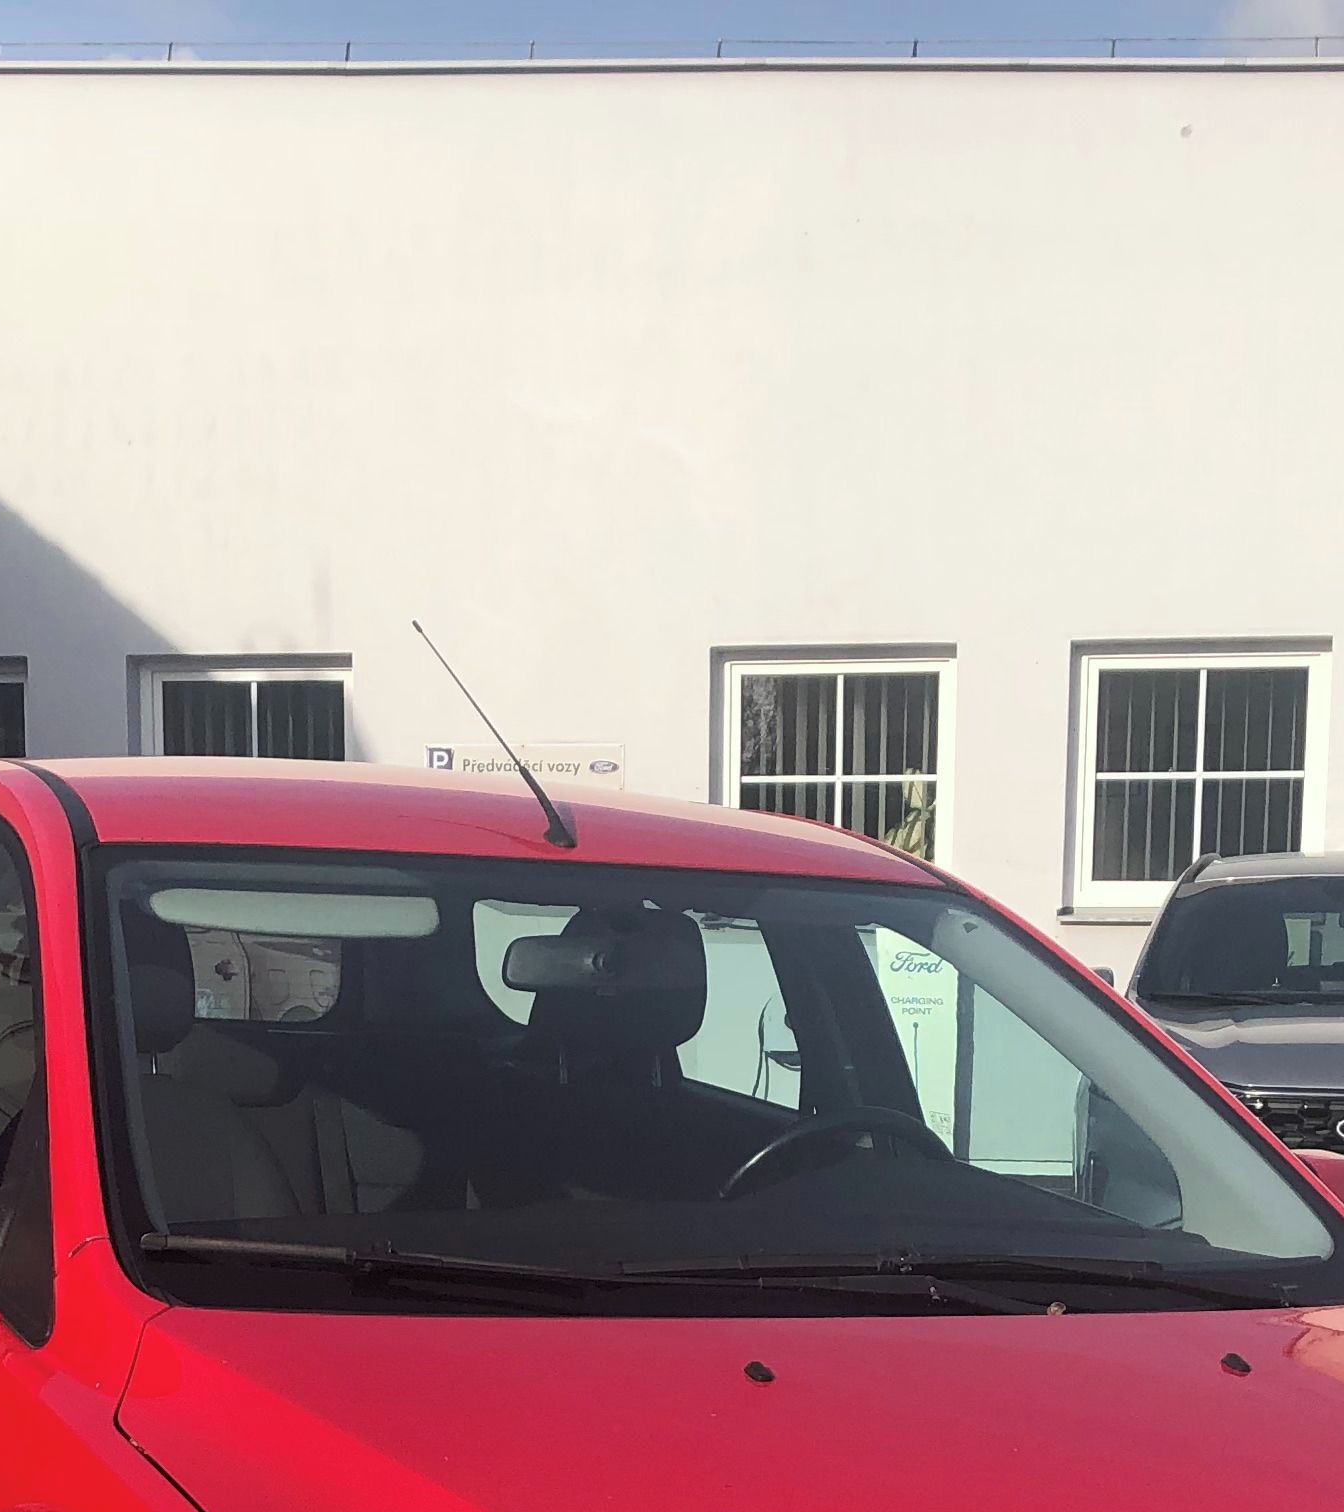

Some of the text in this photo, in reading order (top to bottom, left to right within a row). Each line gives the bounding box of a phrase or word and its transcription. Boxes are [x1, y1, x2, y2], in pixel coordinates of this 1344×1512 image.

[433, 751, 449, 769] P
[547, 763, 581, 776] vozy
[890, 951, 943, 974] Ford
[890, 996, 944, 1005] CHARGING
[902, 1007, 932, 1016] POINT
